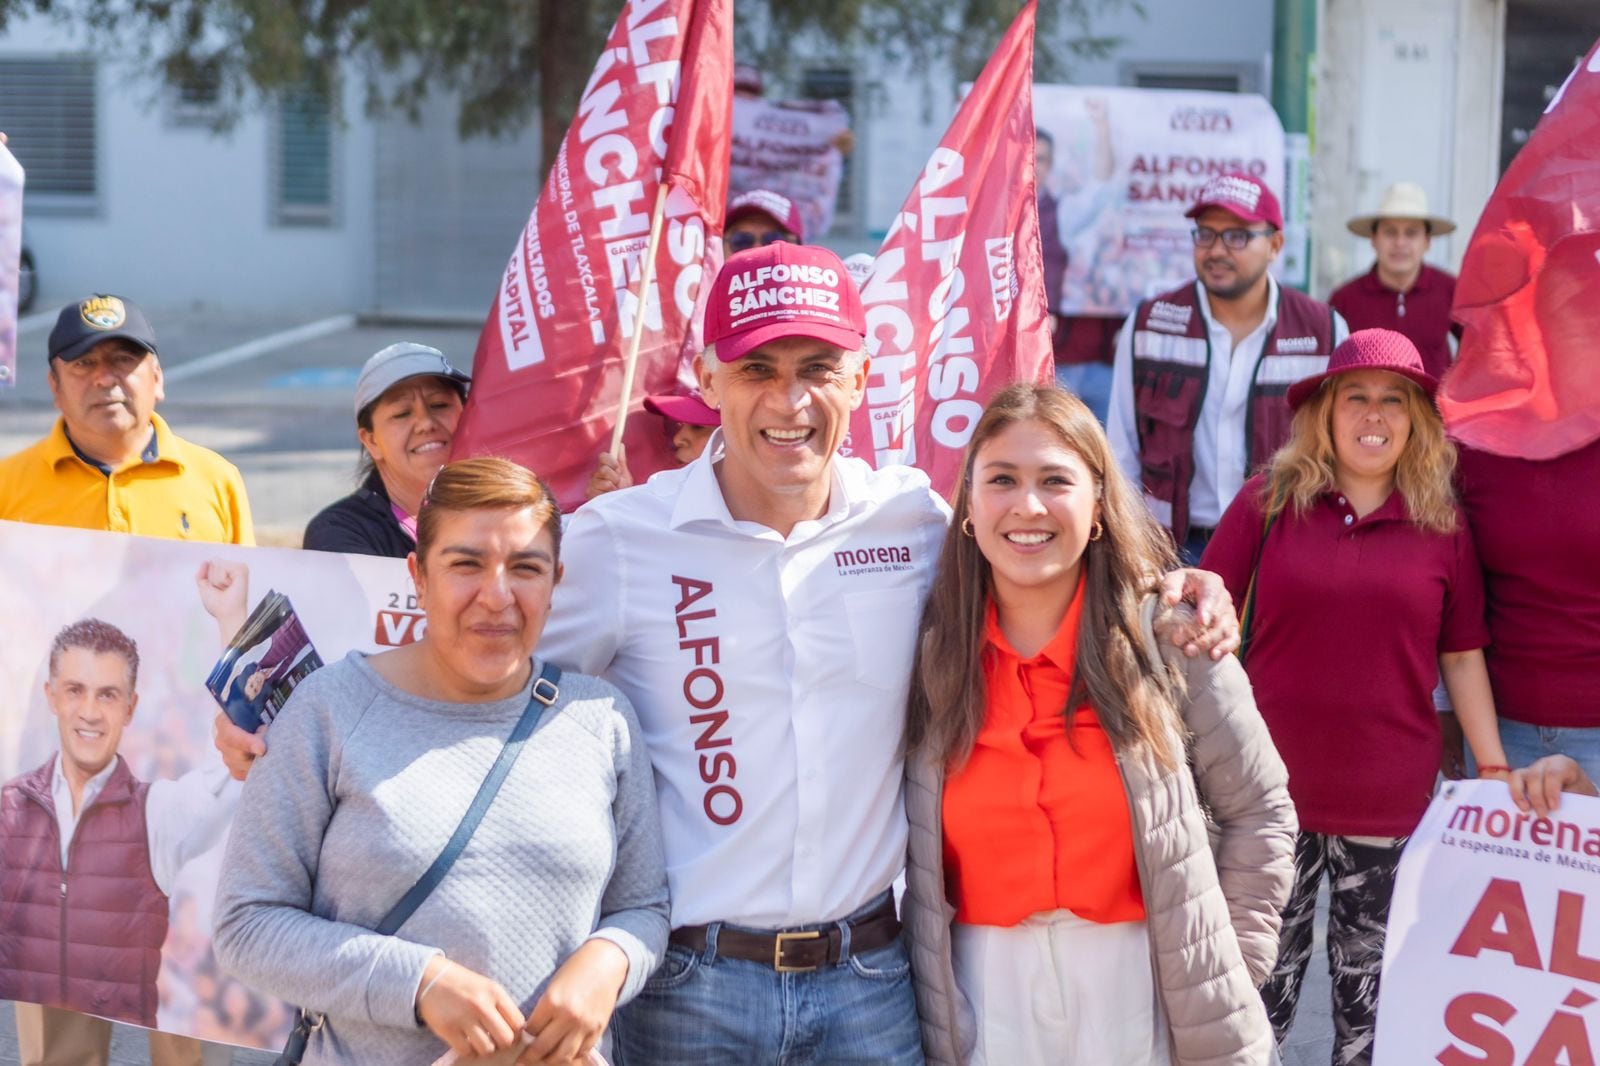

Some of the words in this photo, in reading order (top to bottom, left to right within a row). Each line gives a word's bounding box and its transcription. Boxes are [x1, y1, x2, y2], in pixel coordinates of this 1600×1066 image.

[564, 210, 581, 234] DE
[571, 232, 600, 322] TLAXCALA
[728, 264, 839, 295] ALFONSO
[729, 286, 840, 317] SÁNCHEZ
[833, 546, 912, 568] morena
[849, 564, 883, 576] esperanza
[884, 564, 892, 572] de
[388, 592, 399, 608] 2
[671, 574, 743, 825] ALFONSO
[1447, 804, 1600, 858] morena
[1441, 832, 1456, 846] La
[1459, 837, 1530, 861] esperanza
[1534, 849, 1552, 864] de
